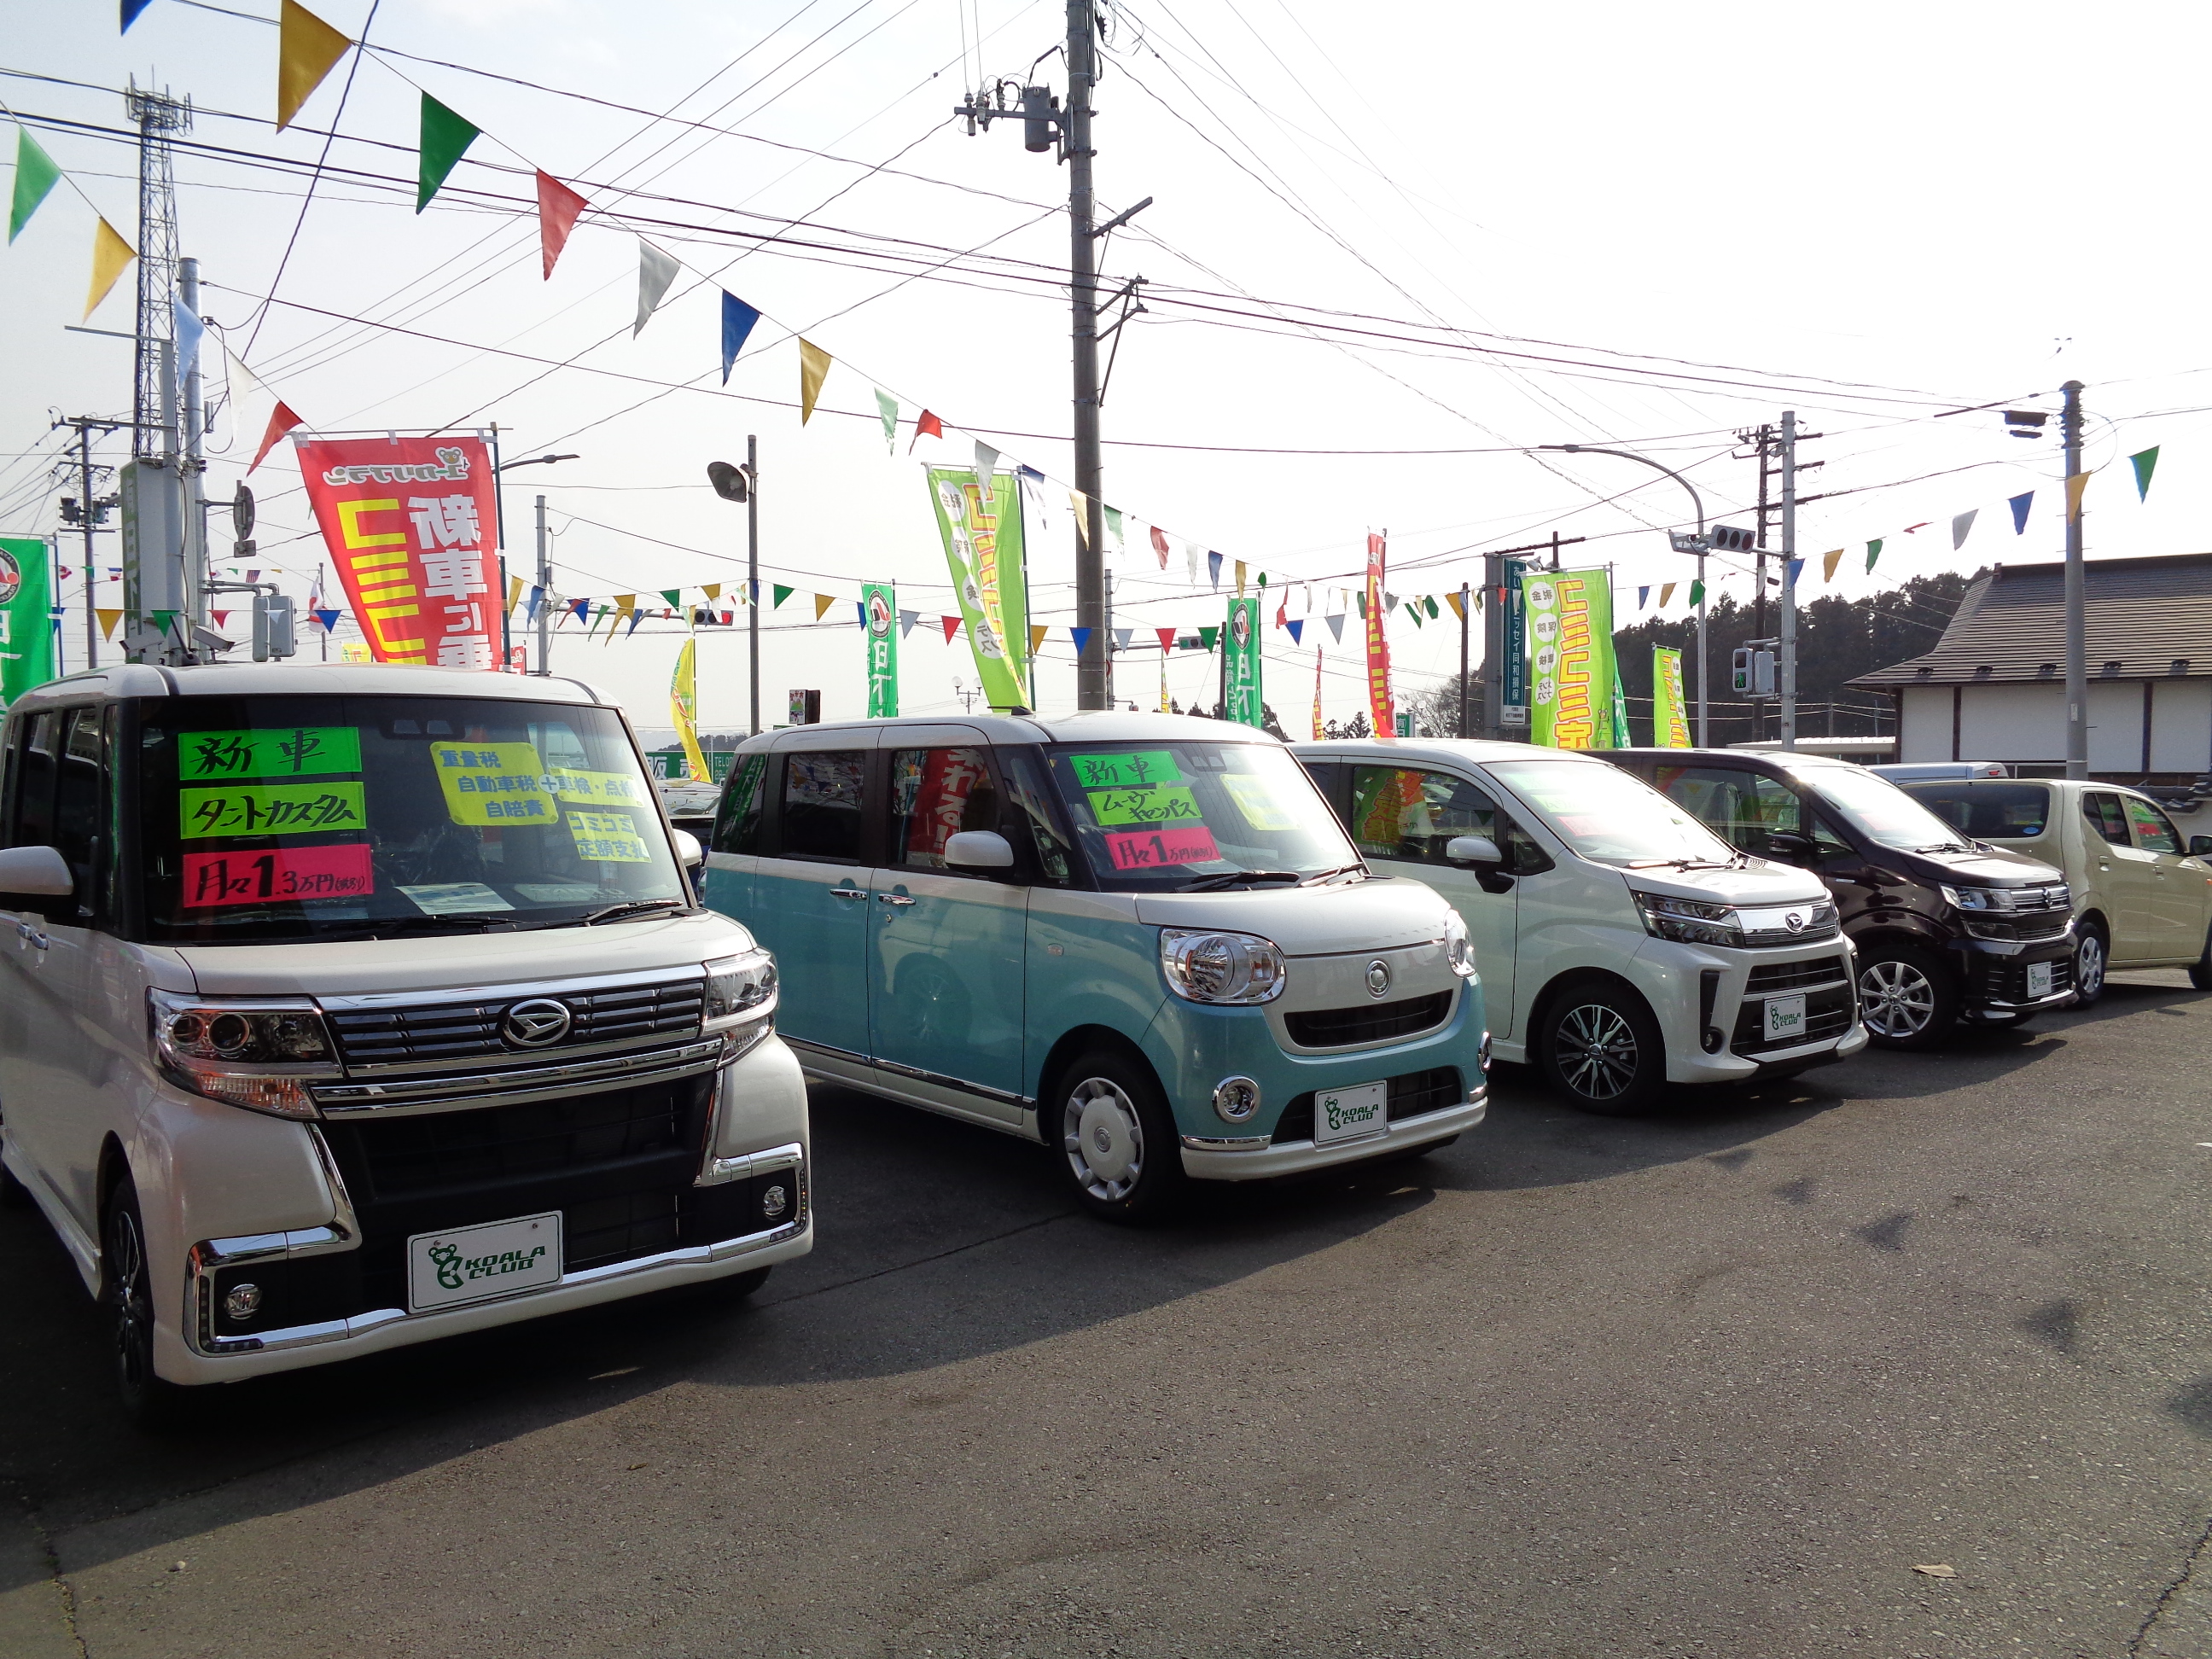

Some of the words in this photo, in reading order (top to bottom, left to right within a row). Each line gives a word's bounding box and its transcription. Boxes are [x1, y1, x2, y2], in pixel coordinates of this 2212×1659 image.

[1511, 566, 1521, 701] あいニッセイ同和損保
[189, 730, 326, 775] 新車
[439, 749, 501, 769] 重量税
[1084, 754, 1155, 785] 新車
[457, 775, 538, 793] 自動車税
[191, 794, 358, 833] タントカスタム
[485, 799, 546, 818] 自賠責
[569, 816, 635, 834] コミコミ
[1779, 1012, 1802, 1022] KOALA
[1341, 1103, 1379, 1118] KOALA
[1342, 1112, 1374, 1125] CLUB
[464, 1245, 546, 1271] KOALA
[469, 1258, 535, 1280] CLUB
